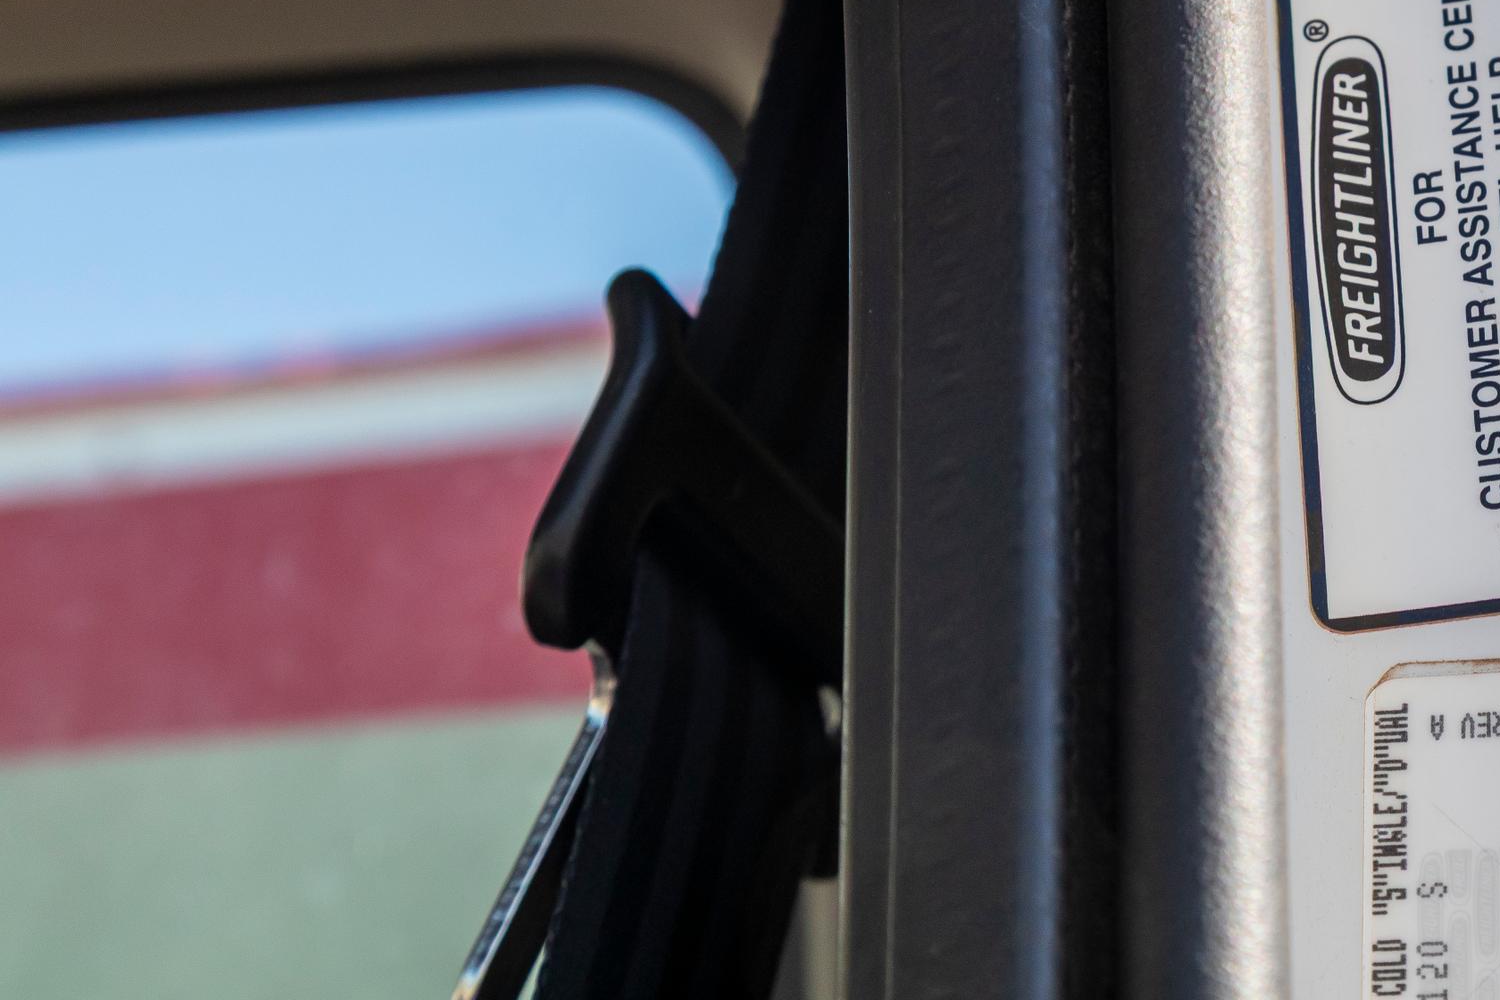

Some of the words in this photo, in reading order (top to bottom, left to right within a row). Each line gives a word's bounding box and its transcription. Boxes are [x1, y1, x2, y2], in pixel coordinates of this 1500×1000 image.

[1446, 61, 1495, 287] ASSISTANCE
[1331, 73, 1385, 365] FREIGHTLINER
[1412, 169, 1447, 246] FOR
[1430, 714, 1446, 742] A
[1416, 881, 1449, 900] S
[1371, 939, 1408, 998] COLD
[1416, 940, 1450, 1000] 120
